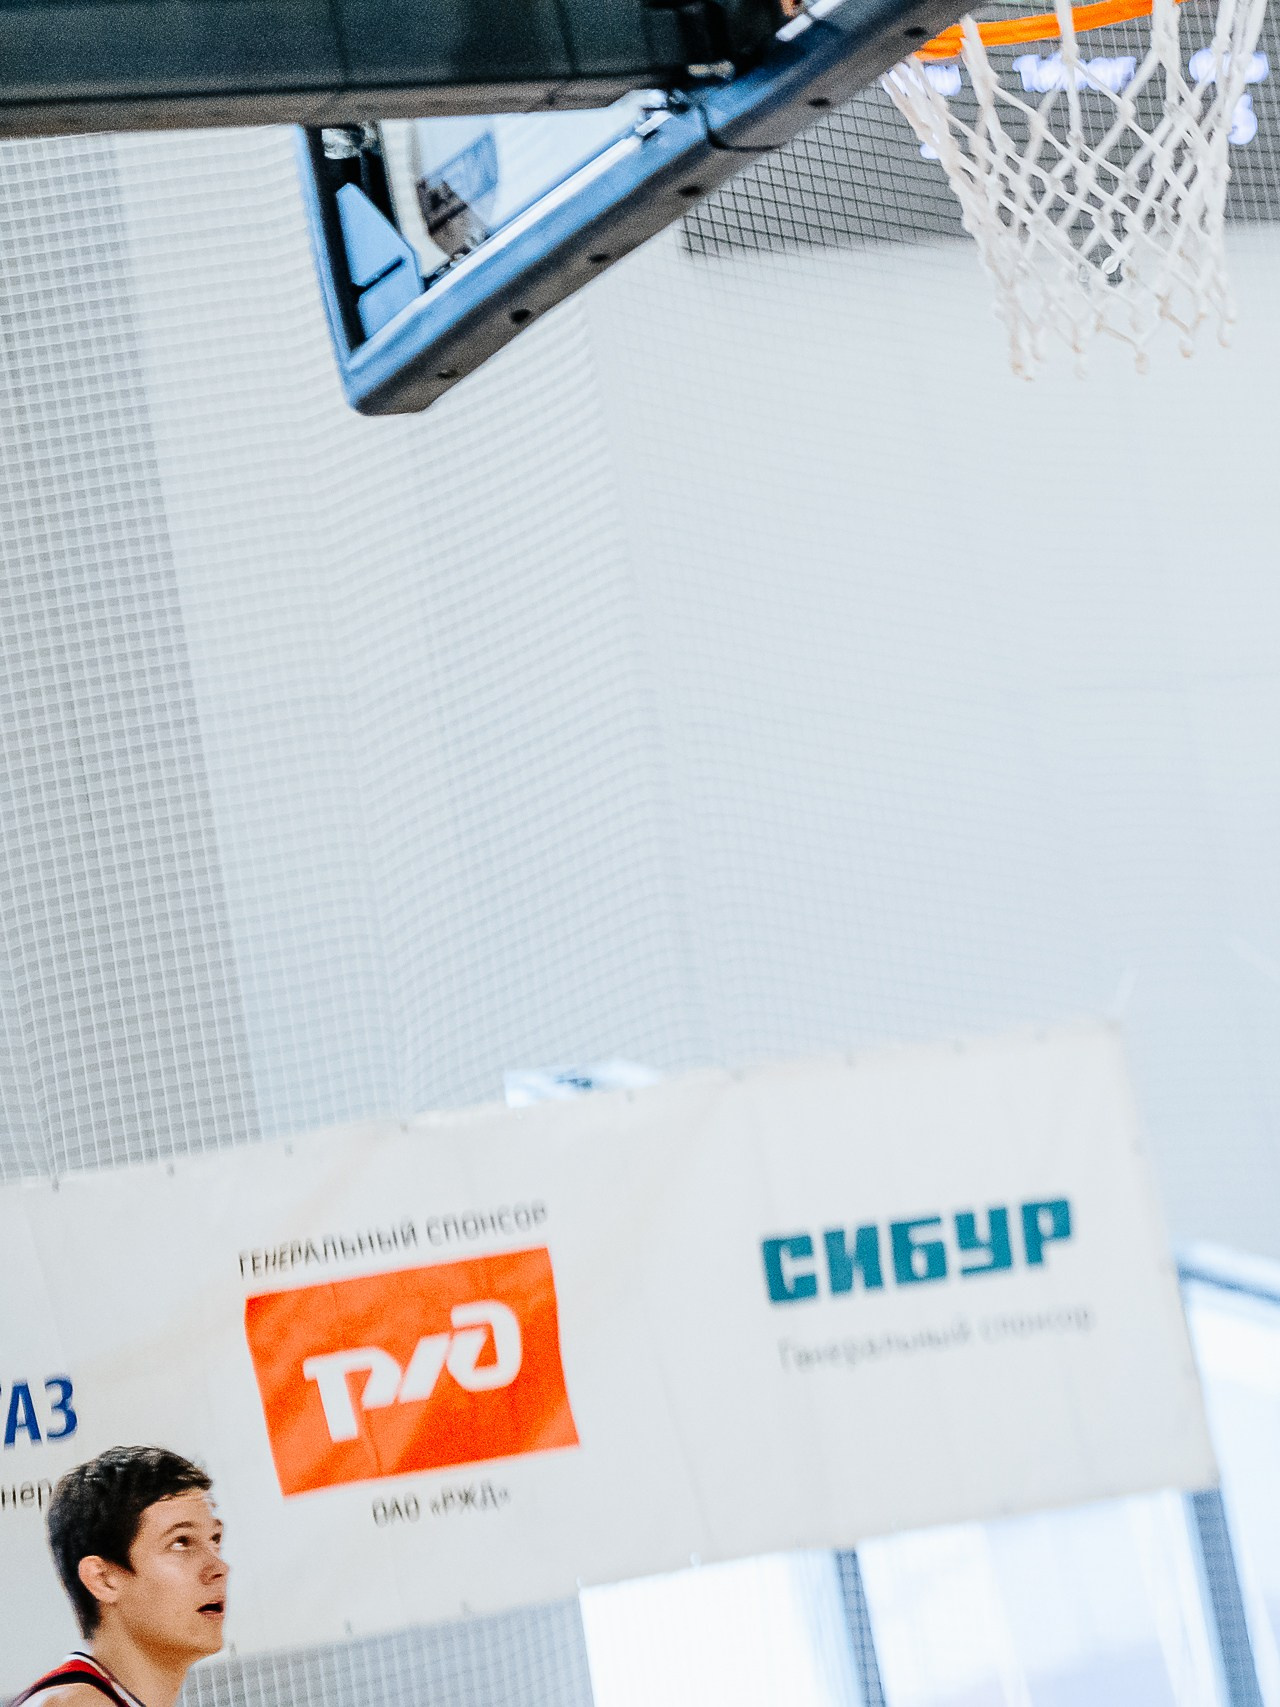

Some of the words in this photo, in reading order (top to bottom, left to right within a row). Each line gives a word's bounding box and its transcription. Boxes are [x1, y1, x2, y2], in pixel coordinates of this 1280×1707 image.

[238, 1214, 418, 1281] ГЕНЕРАЛЬНЫЙ
[761, 1197, 1072, 1304] СИБУР
[0, 1375, 78, 1449] АЗ
[372, 1494, 421, 1528] ОАО
